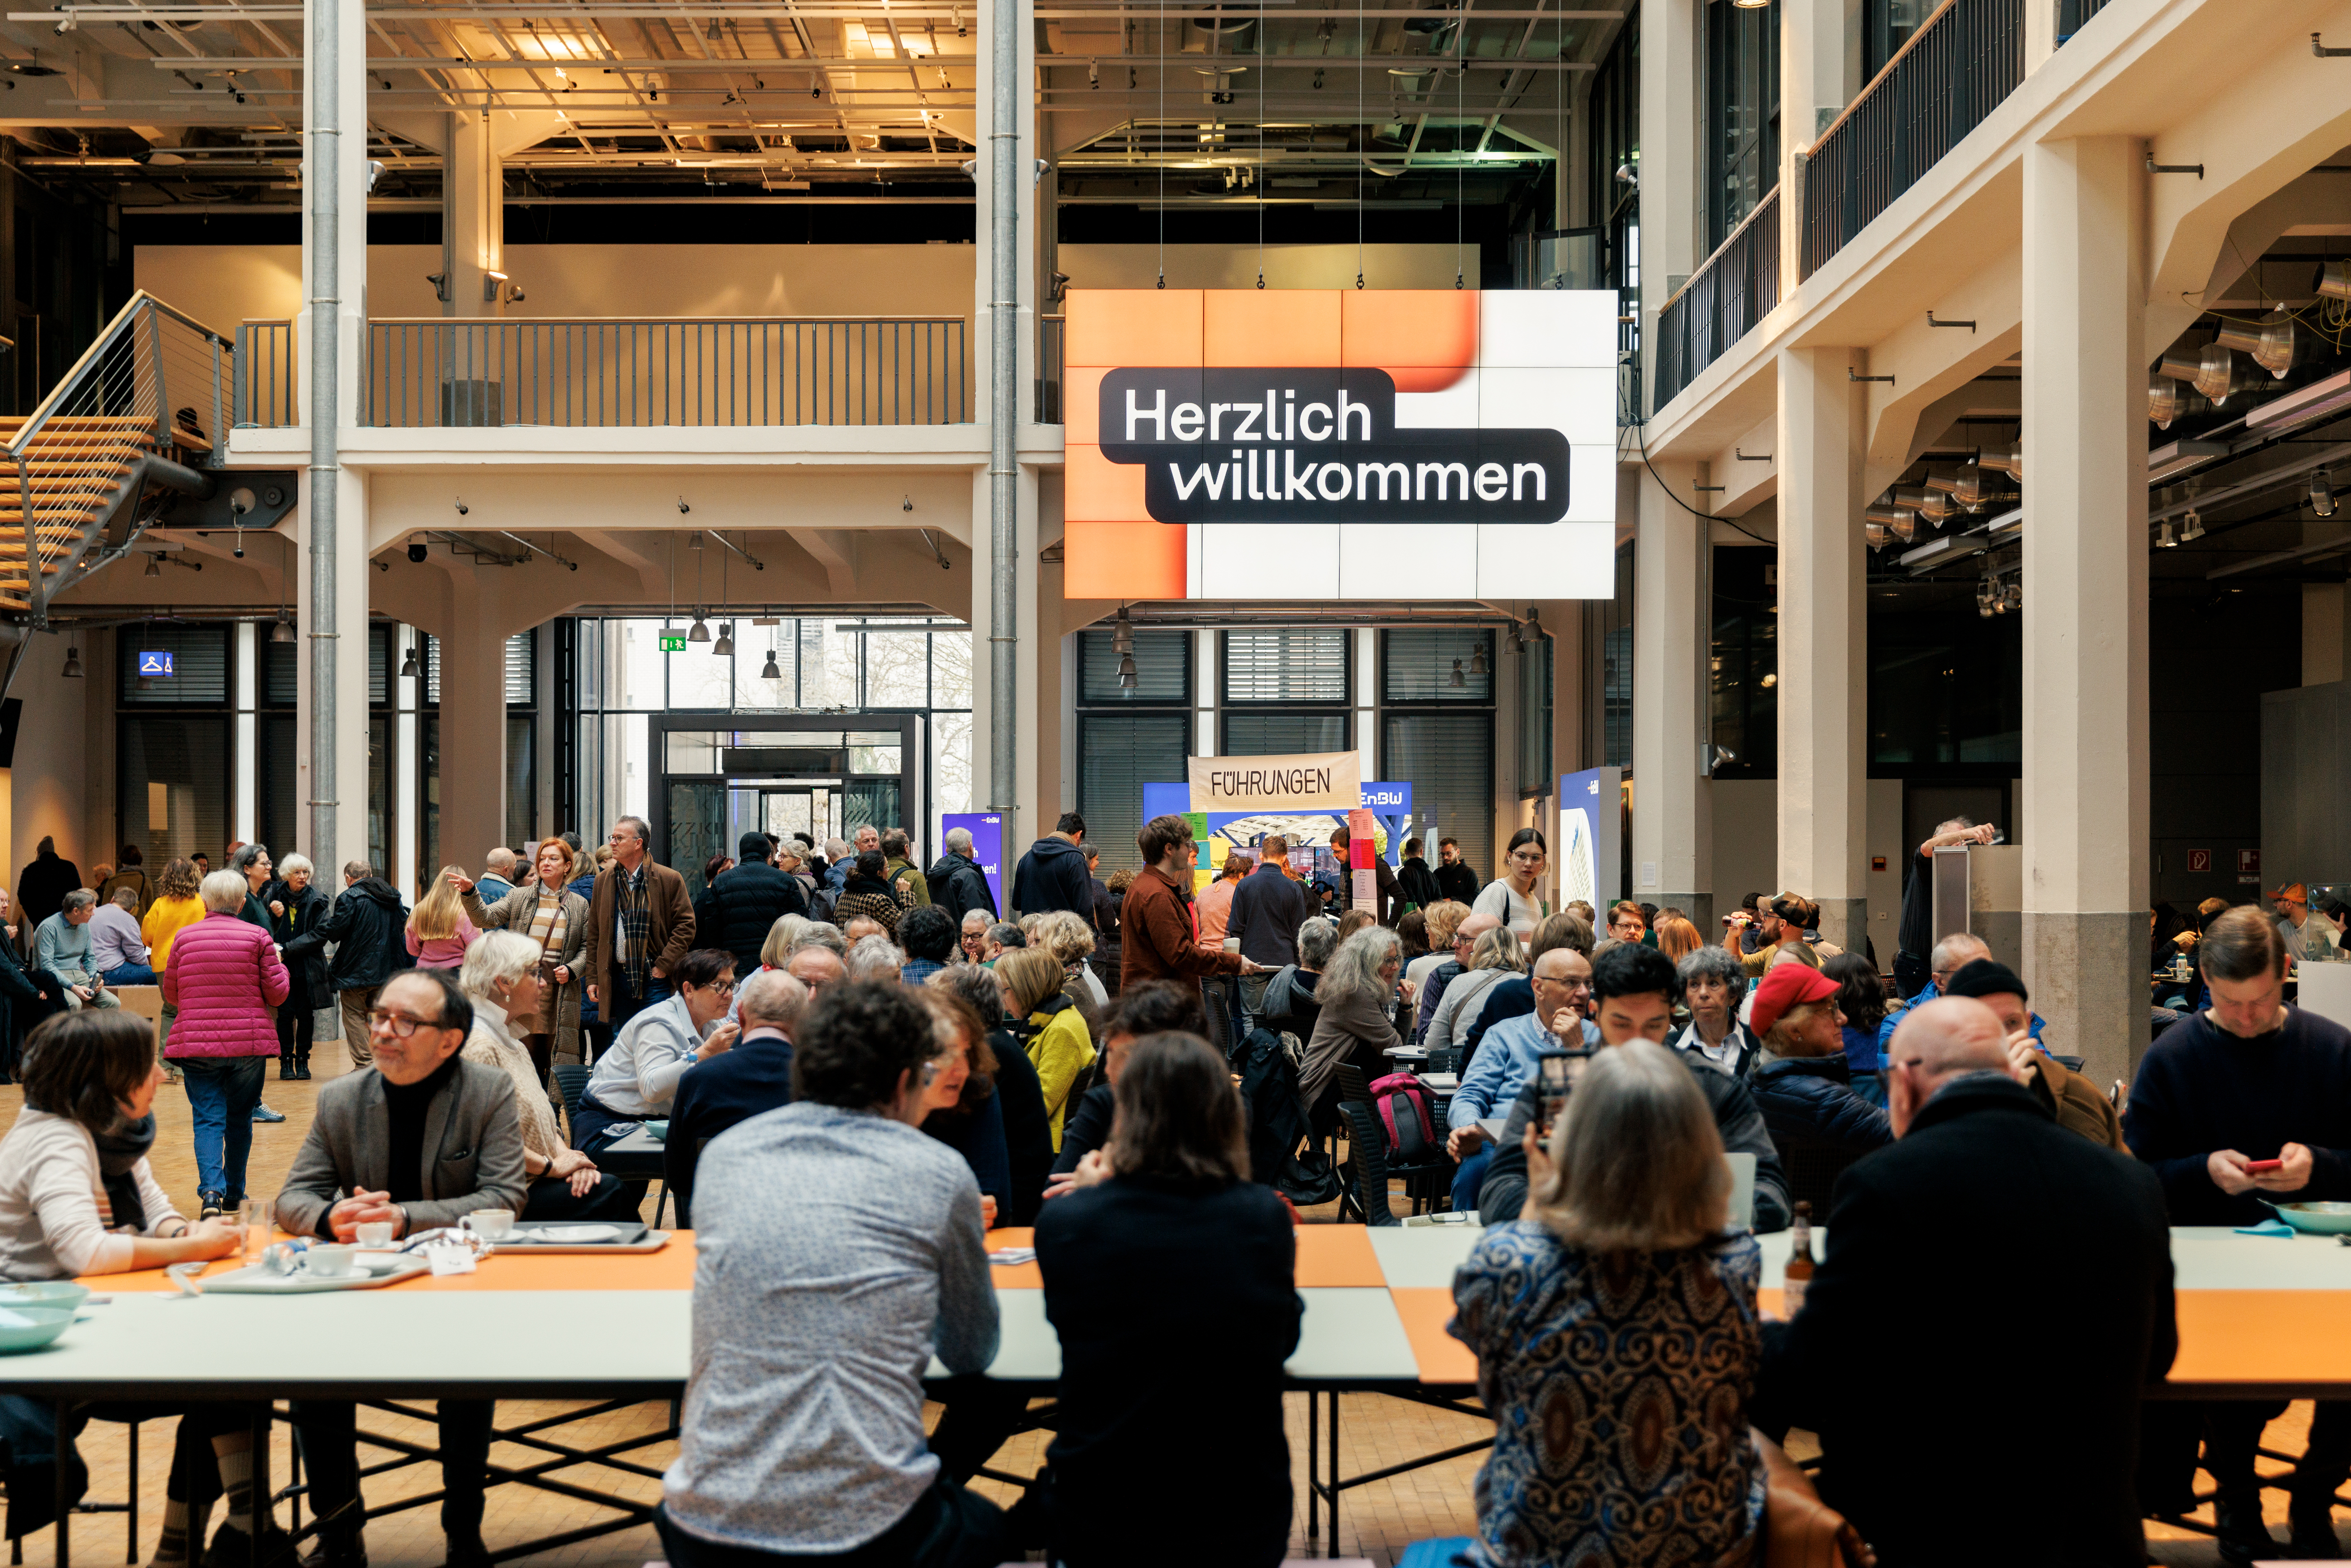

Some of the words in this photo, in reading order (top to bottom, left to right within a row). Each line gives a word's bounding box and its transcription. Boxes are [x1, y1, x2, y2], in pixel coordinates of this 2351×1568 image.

[1126, 389, 1371, 441] Herzlich
[1170, 449, 1546, 501] willkommen
[1211, 767, 1330, 796] FÜHRUNGEN
[1361, 792, 1402, 805] EnBW
